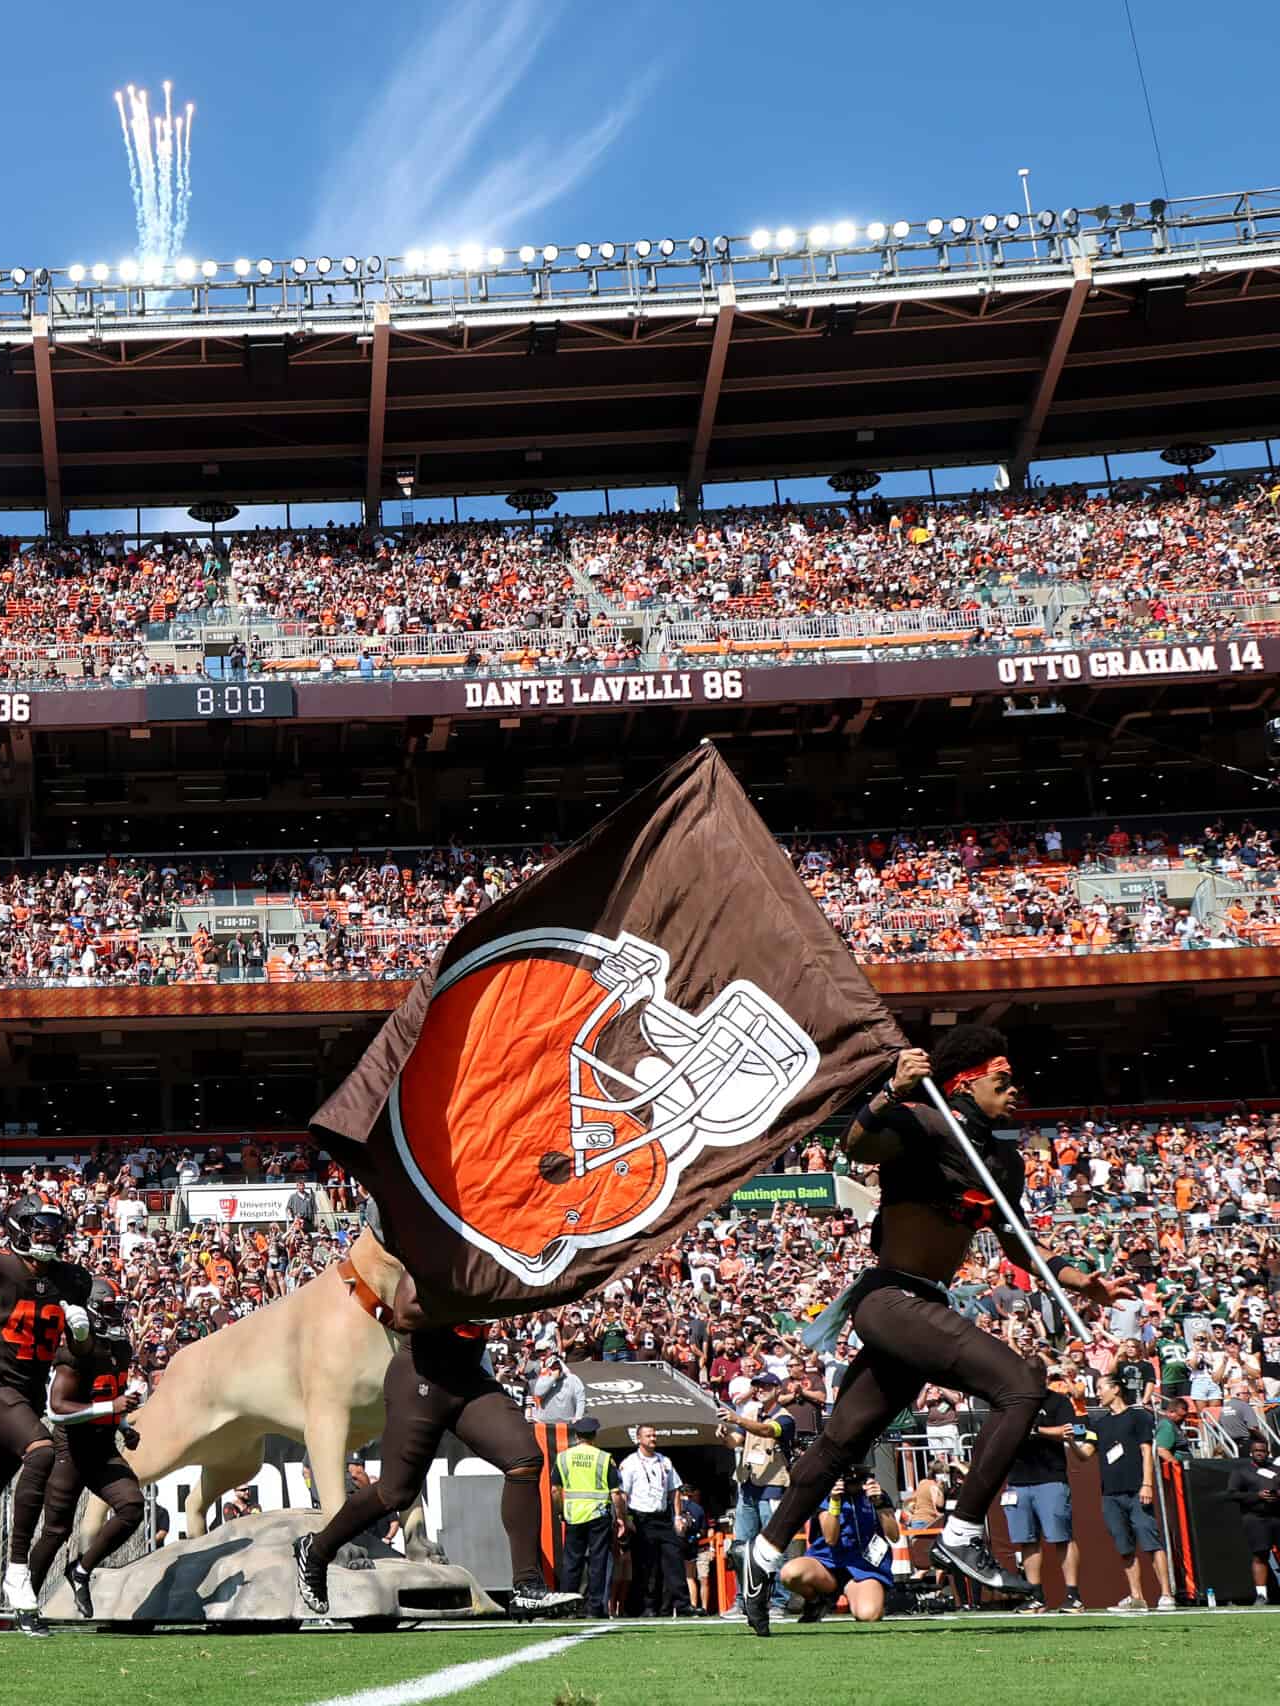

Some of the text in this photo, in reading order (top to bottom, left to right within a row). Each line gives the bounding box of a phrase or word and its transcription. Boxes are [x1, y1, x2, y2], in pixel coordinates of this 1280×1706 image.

[997, 641, 1265, 684] OTTO GRAHAM 14
[197, 686, 265, 714] 8:00
[464, 670, 743, 708] DANTE LAVELLI 86
[239, 1200, 282, 1209] University
[798, 1186, 828, 1199] Bank
[239, 1209, 279, 1218] Hospitals
[1, 1299, 65, 1361] 43
